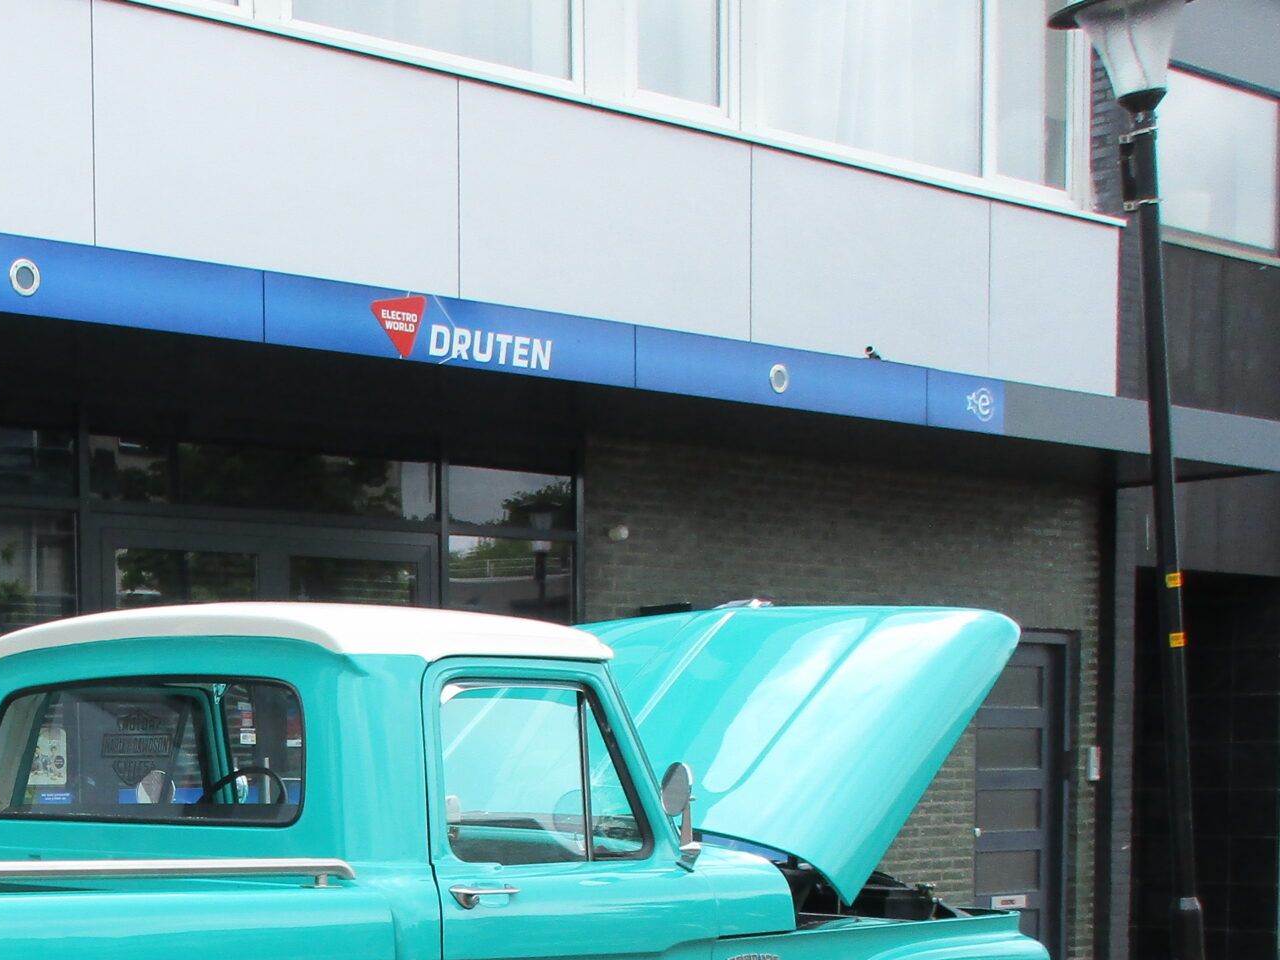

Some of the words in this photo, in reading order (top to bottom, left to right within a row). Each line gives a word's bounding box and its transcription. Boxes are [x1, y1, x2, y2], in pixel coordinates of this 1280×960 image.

[381, 309, 418, 323] ELECTRO
[385, 321, 415, 333] WORLD
[429, 324, 553, 371] DRUTEN
